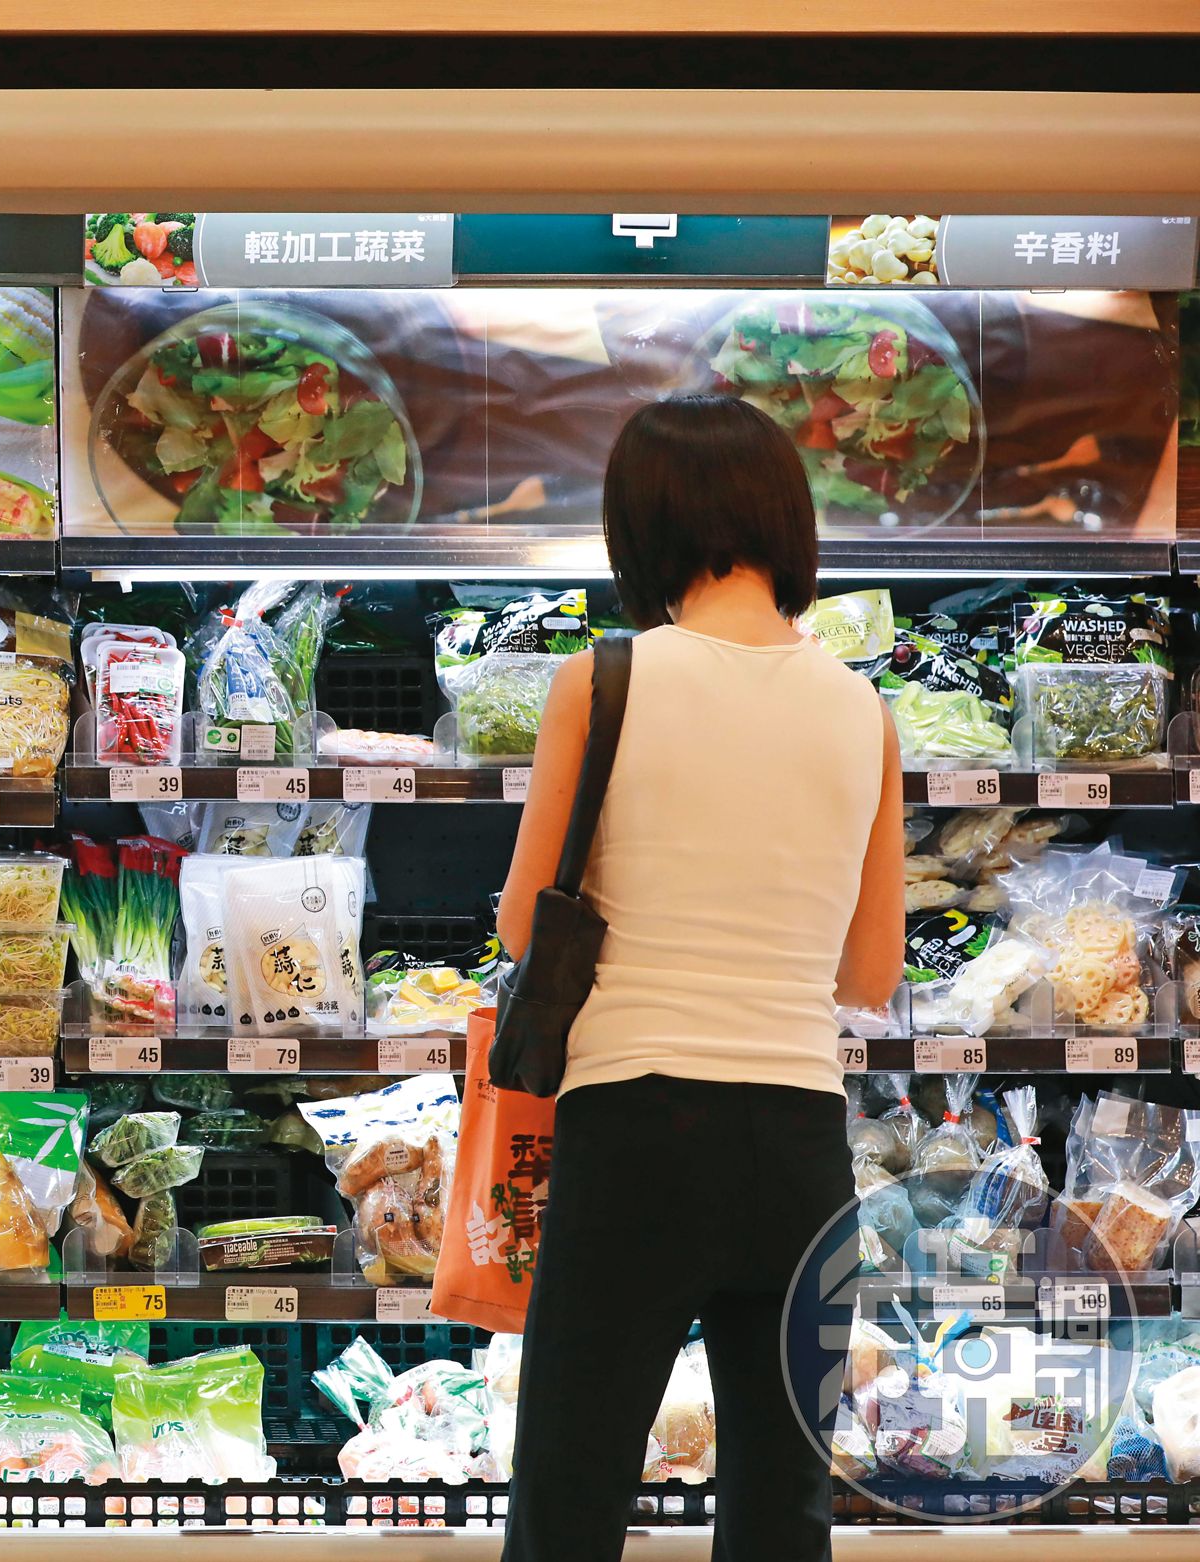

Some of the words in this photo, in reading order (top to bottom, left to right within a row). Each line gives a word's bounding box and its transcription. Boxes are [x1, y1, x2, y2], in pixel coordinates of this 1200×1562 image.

[245, 230, 426, 264] 輕加工蔬菜
[1014, 231, 1121, 265] 辛香料
[1063, 620, 1127, 632] WASHED
[1066, 643, 1126, 656] VEGGIES
[159, 776, 179, 793] 39
[285, 778, 306, 794] 45
[392, 777, 413, 794] 49
[976, 778, 997, 795] 85
[1087, 783, 1108, 800] 59
[137, 1047, 159, 1063] 45
[276, 1048, 297, 1065] 79
[426, 1048, 447, 1065] 45
[843, 1048, 865, 1064] 79
[963, 1048, 984, 1065] 85
[1114, 1047, 1135, 1063] 89
[30, 1067, 50, 1083] 39
[142, 1294, 164, 1310] 75
[274, 1297, 295, 1313] 45
[981, 1295, 1002, 1311] 65
[1078, 1293, 1107, 1310] 109
